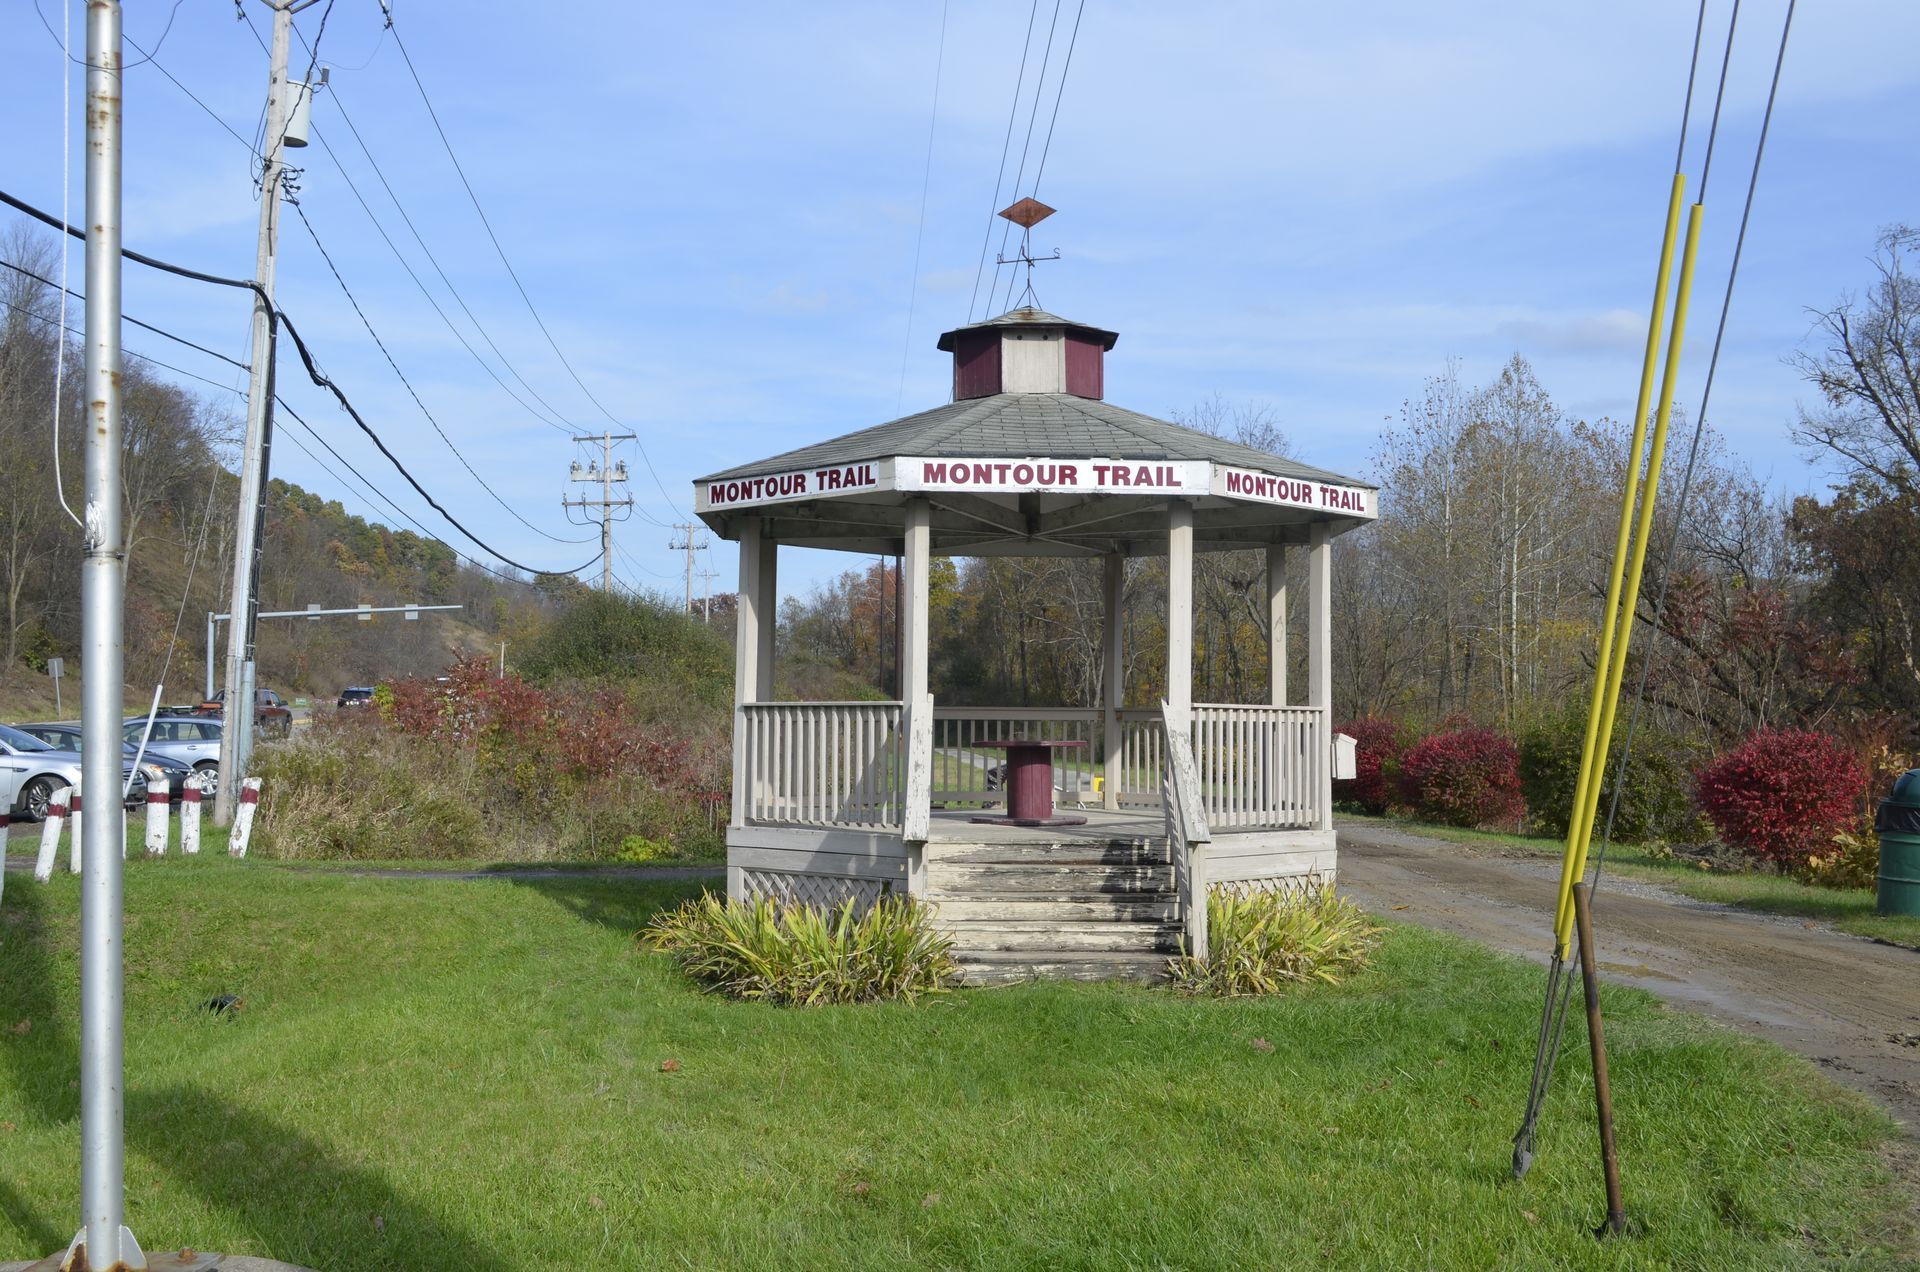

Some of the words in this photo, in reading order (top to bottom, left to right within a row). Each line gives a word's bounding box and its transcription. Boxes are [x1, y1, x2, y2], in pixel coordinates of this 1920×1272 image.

[711, 473, 806, 504] MONTOUR
[816, 465, 876, 491] TRAIL
[923, 463, 1077, 485] MONTOUR
[1093, 465, 1182, 487] TRAIL
[1227, 472, 1312, 504] MONTOUR
[1320, 486, 1365, 512] TRAIL
